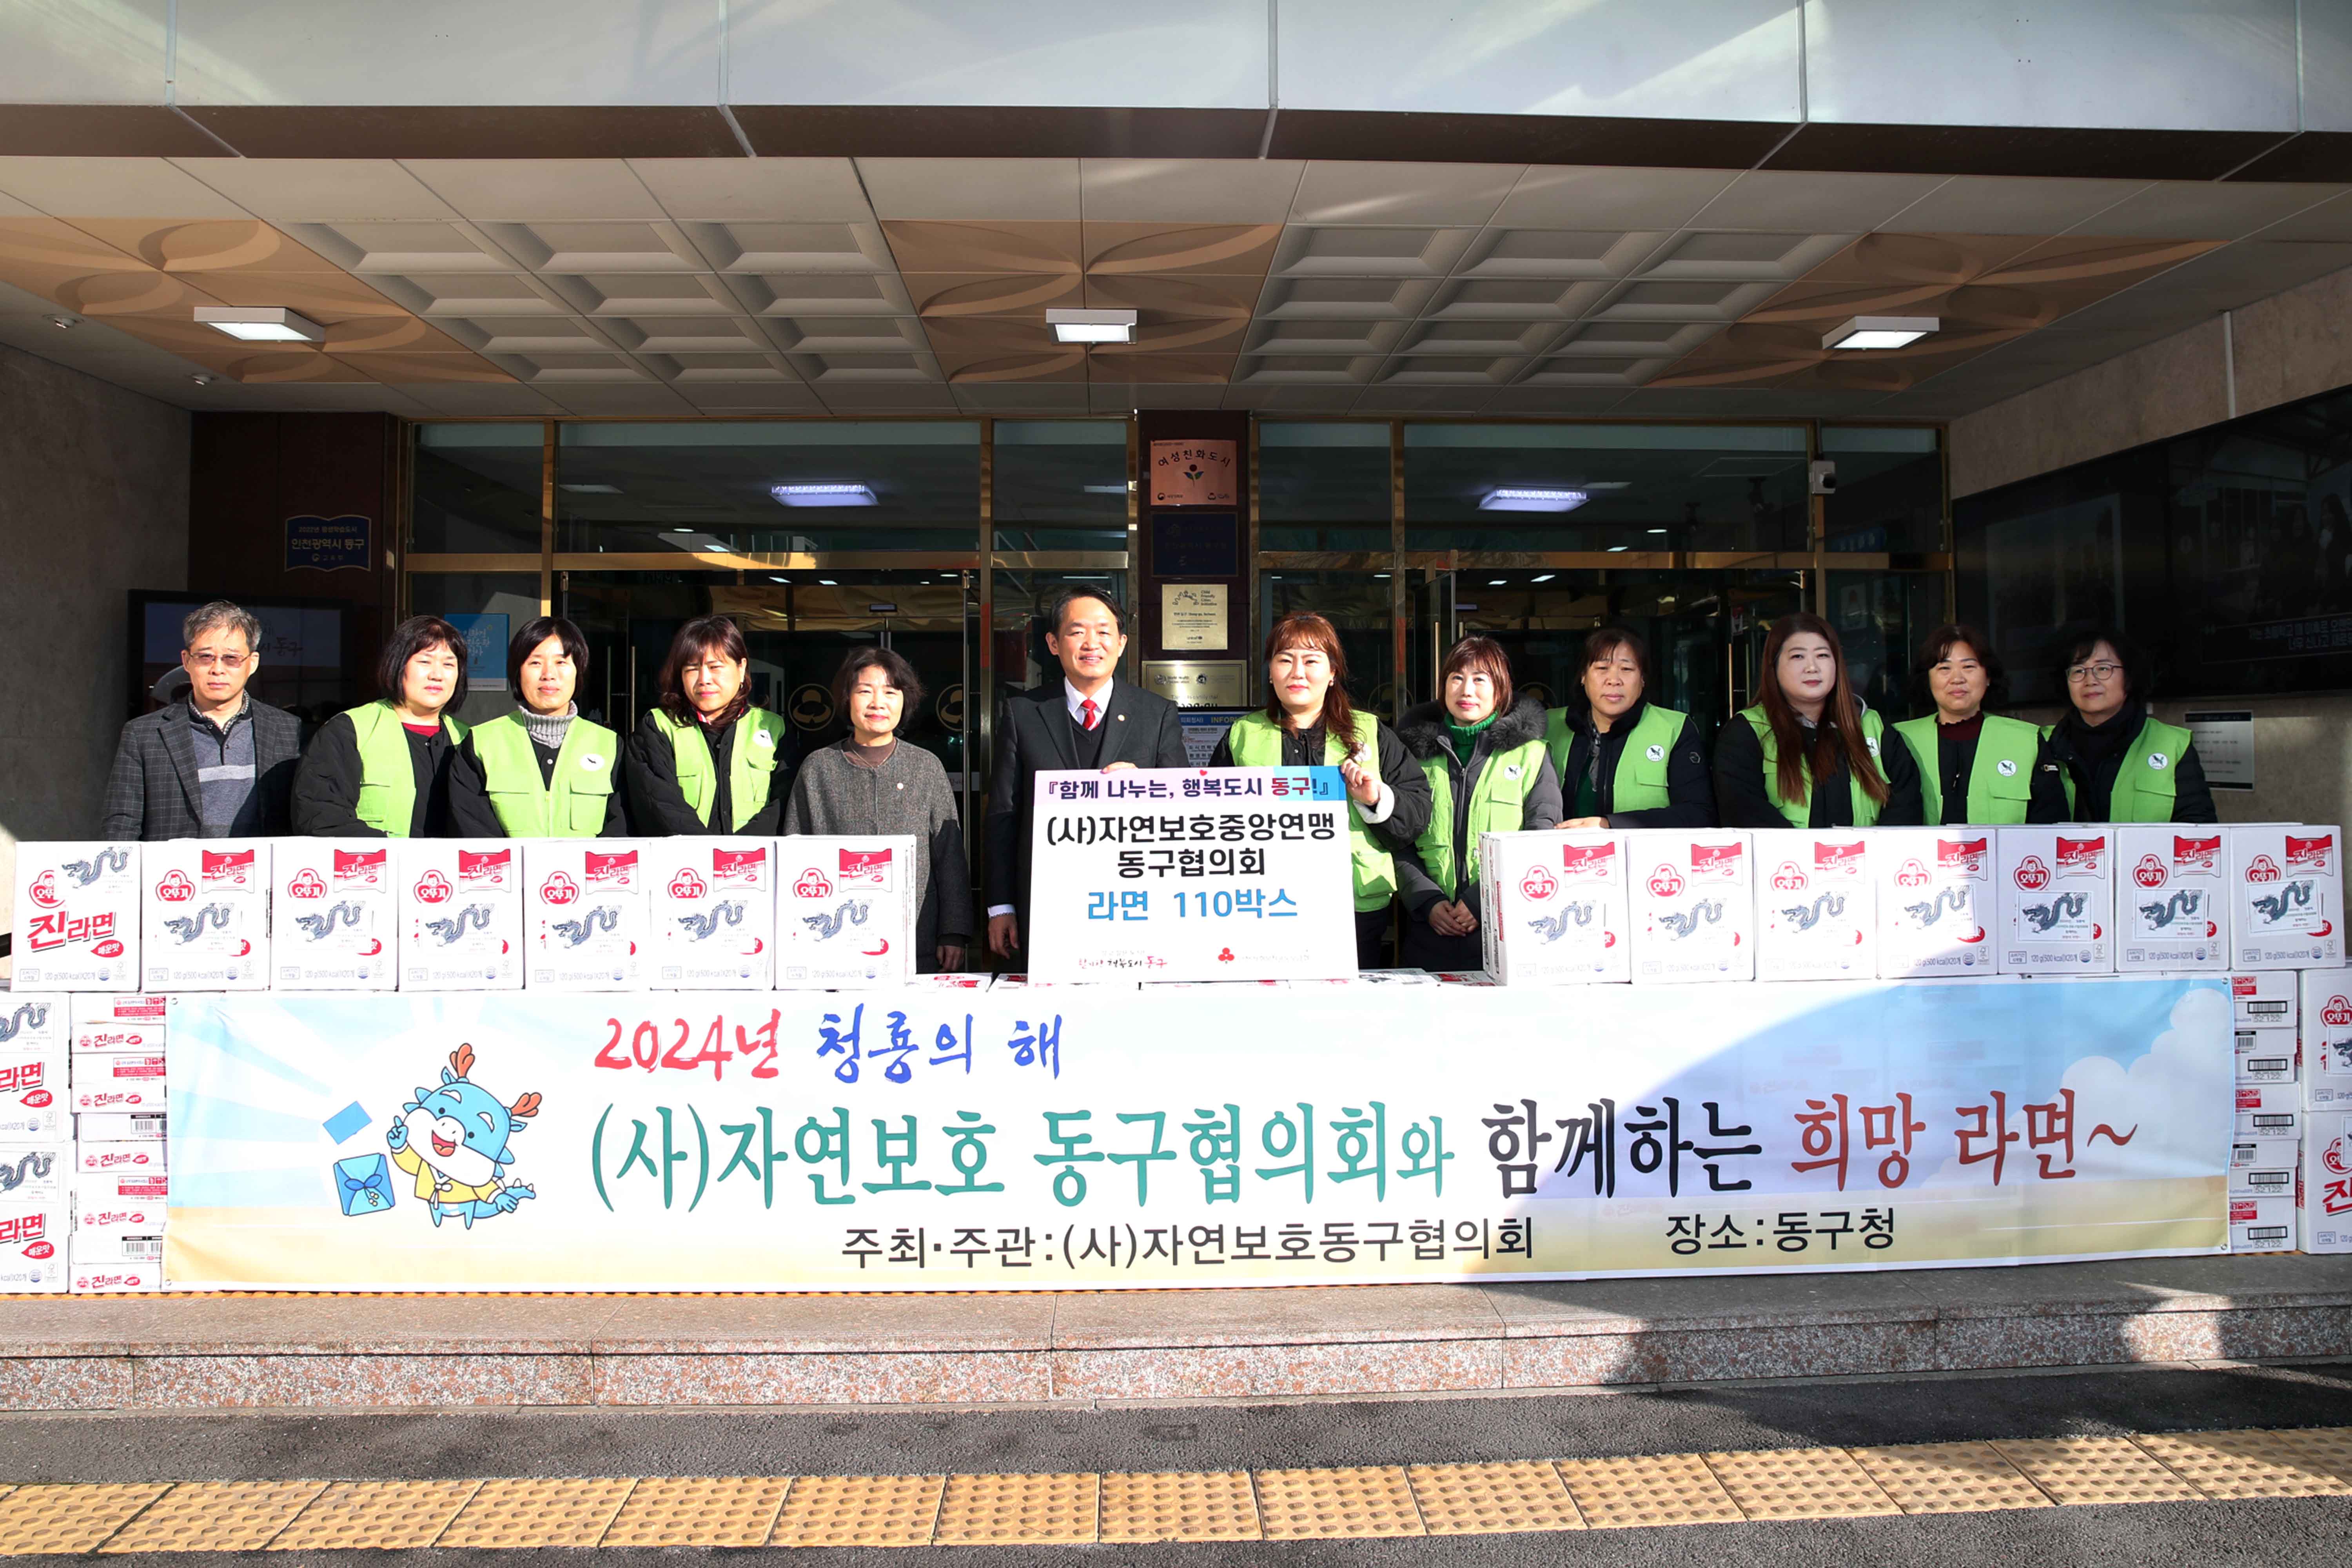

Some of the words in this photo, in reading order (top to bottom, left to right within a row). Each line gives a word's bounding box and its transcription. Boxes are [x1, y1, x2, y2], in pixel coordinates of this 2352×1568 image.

[1158, 449, 1231, 467] 여성친화도시
[291, 539, 341, 550] 인천광역시
[345, 539, 365, 550] 동구
[1049, 780, 1098, 799] 『함께
[1107, 780, 1174, 799] 나누는,
[1182, 777, 1262, 797] 행복도시
[1047, 813, 1335, 846] (사)자연보호중앙연맹
[1118, 848, 1265, 878] 동구협의회
[2020, 873, 2044, 883] 오뚜기
[2139, 871, 2161, 882] 오뚜기
[2251, 871, 2274, 881] 오뚜기
[163, 887, 189, 898] 오뚜기
[295, 887, 319, 897] 오뚜기
[421, 887, 446, 898] 오뚜기
[675, 887, 700, 897] 오뚜기
[800, 887, 826, 896] 오뚜기
[1526, 883, 1551, 894] 오뚜기
[1653, 882, 1678, 892] 오뚜기
[36, 889, 54, 899] 오뚜
[547, 889, 572, 899] 오뚜기
[1088, 891, 1149, 921] 라면
[1173, 888, 1298, 918] 110박스
[27, 911, 116, 953] 진라면
[98, 942, 120, 955] 매운맛
[2327, 1013, 2350, 1023] 오뚜기
[594, 1008, 781, 1081] 2024년
[816, 1002, 973, 1083] 청룡의
[1007, 1014, 1063, 1079] 해
[26, 1093, 49, 1105] 매운맛
[592, 1103, 1005, 1213] (사)자연보호
[1034, 1101, 1455, 1207] 동구협의회와
[1481, 1096, 1762, 1200] 함께하는
[1791, 1091, 1926, 1192] 희망
[1955, 1087, 2139, 1186] 라면~
[28, 1244, 51, 1256] 매운맛
